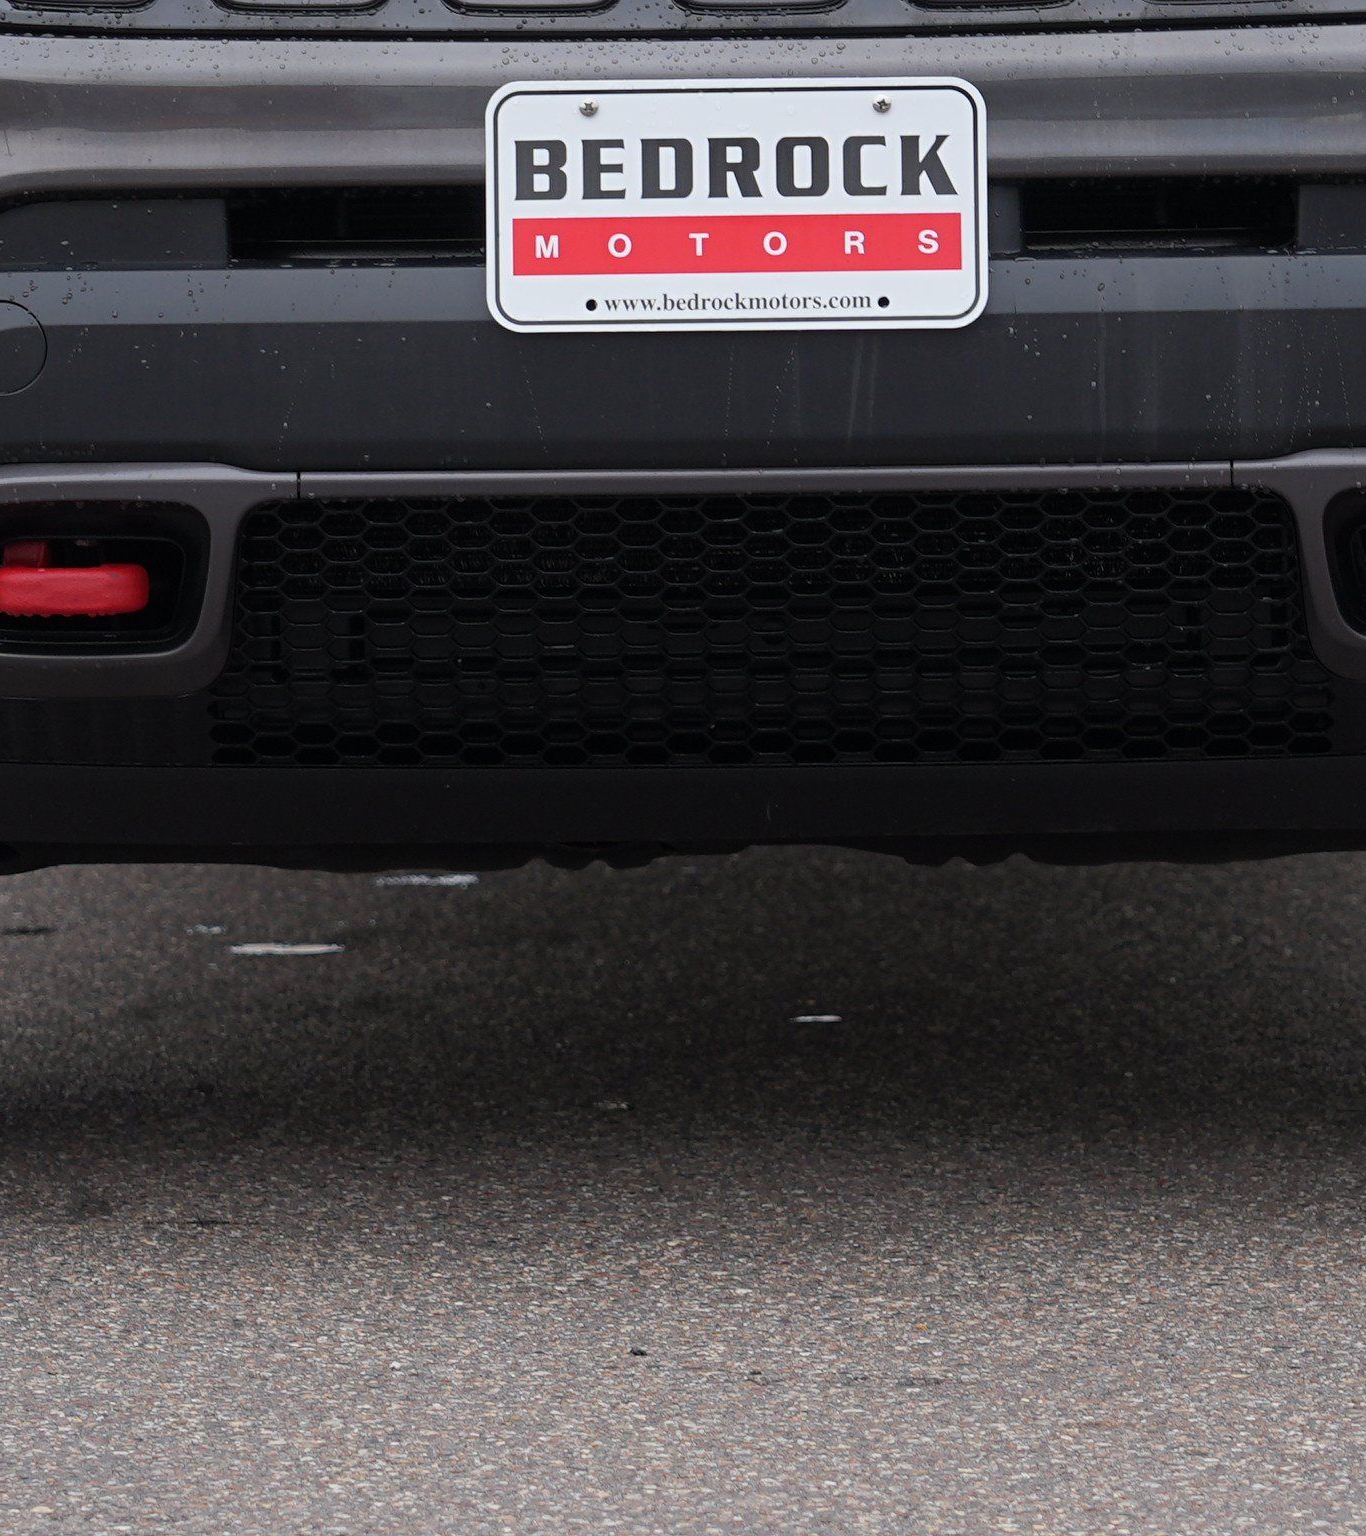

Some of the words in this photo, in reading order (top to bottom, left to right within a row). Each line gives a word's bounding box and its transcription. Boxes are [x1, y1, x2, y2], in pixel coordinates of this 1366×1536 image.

[514, 134, 959, 202] BEDROCK
[534, 229, 941, 260] MOTORS
[603, 291, 872, 313] www.bedrockmotors.com
